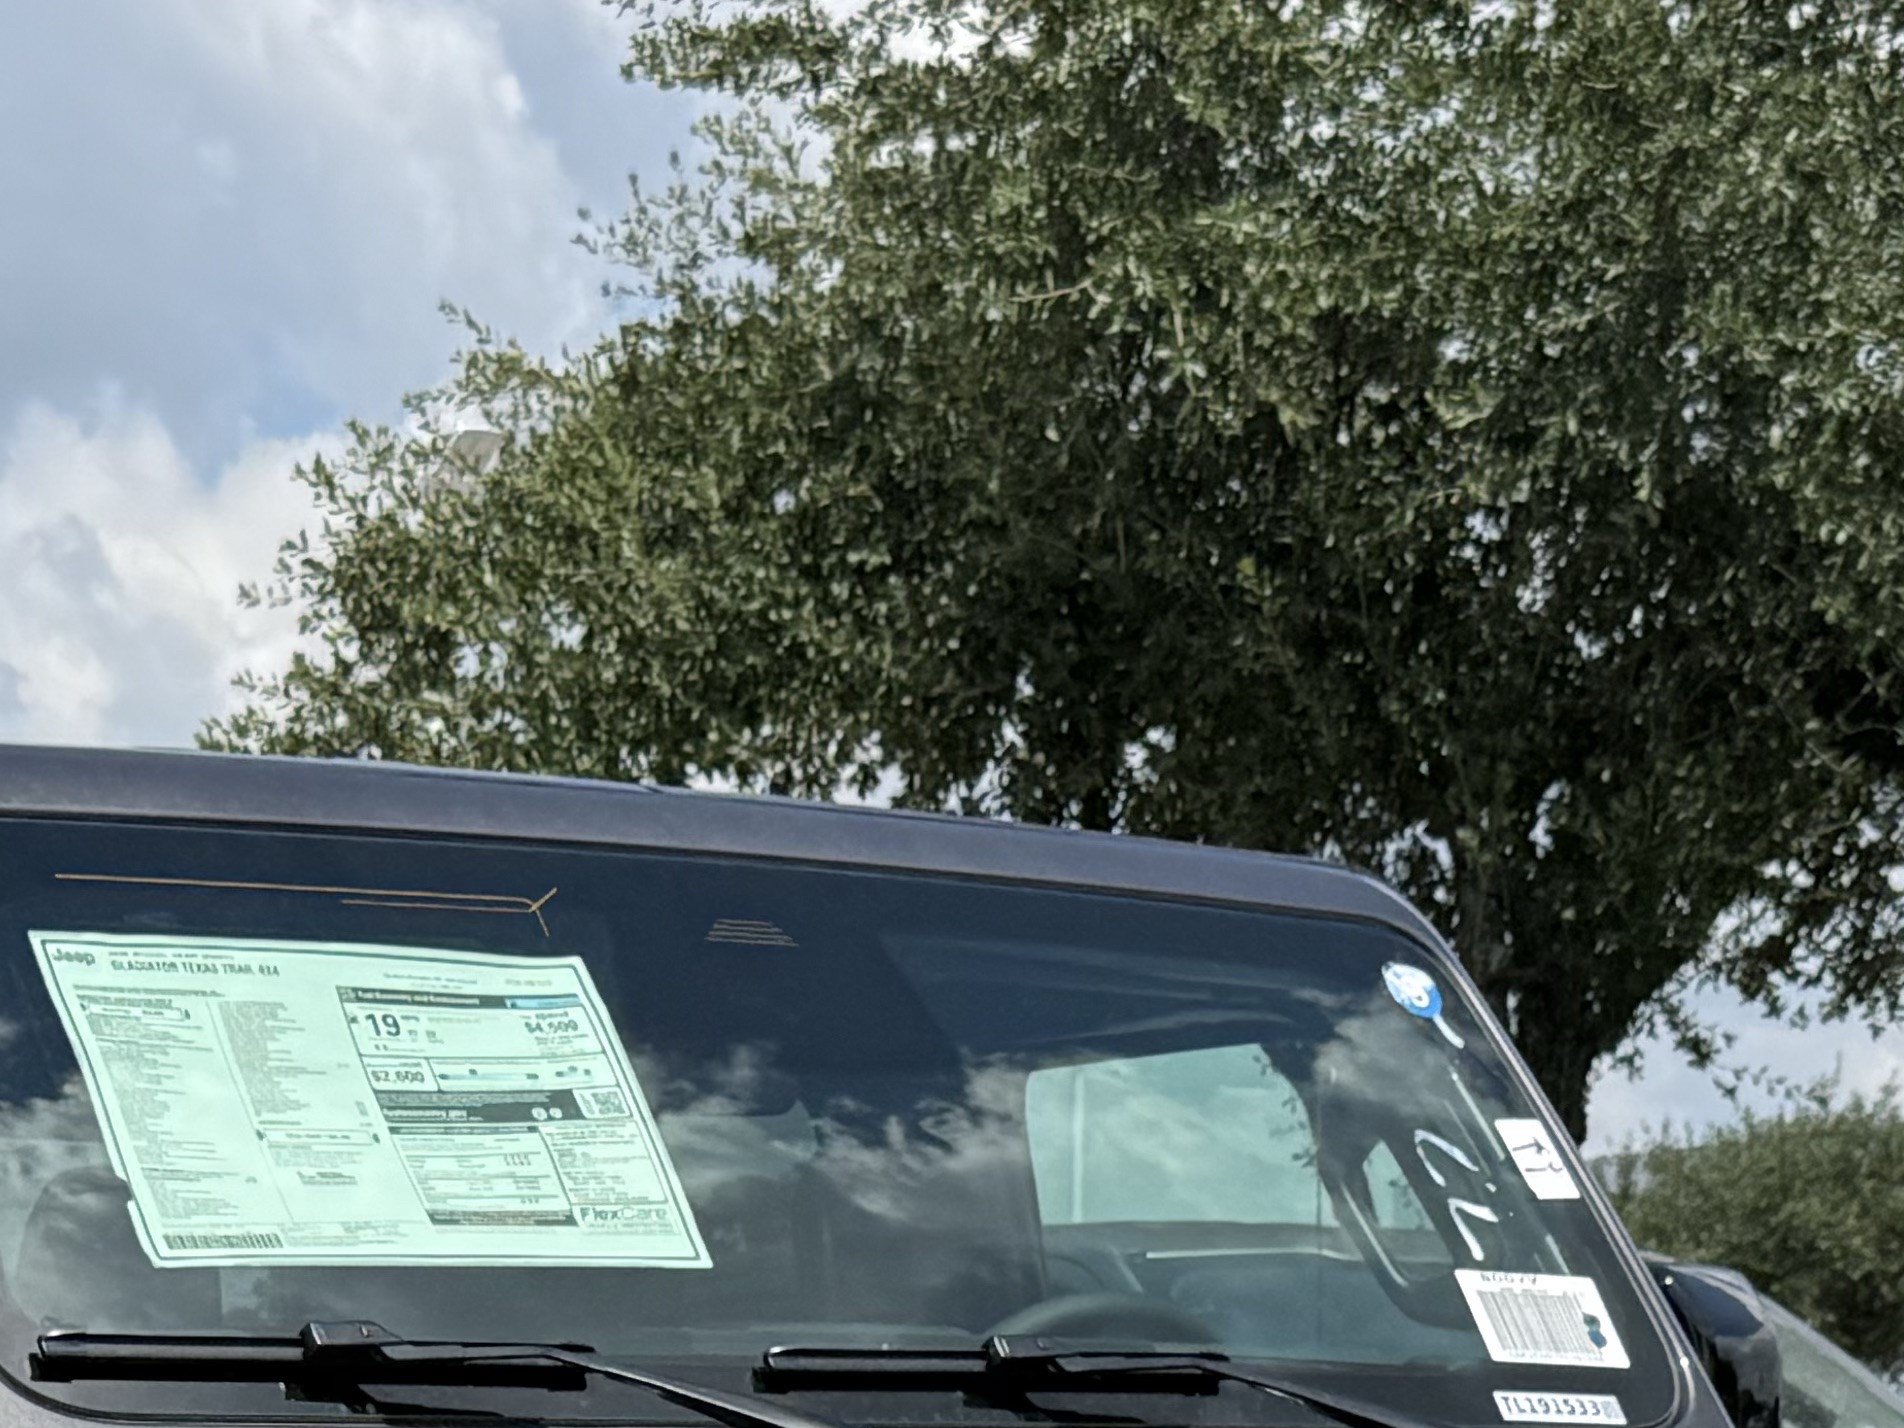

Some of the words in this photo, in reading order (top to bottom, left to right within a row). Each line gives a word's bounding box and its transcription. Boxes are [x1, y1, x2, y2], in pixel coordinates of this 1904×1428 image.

[53, 949, 96, 966] Jeep
[183, 962, 218, 975] TEXAS
[366, 1014, 401, 1036] 19
